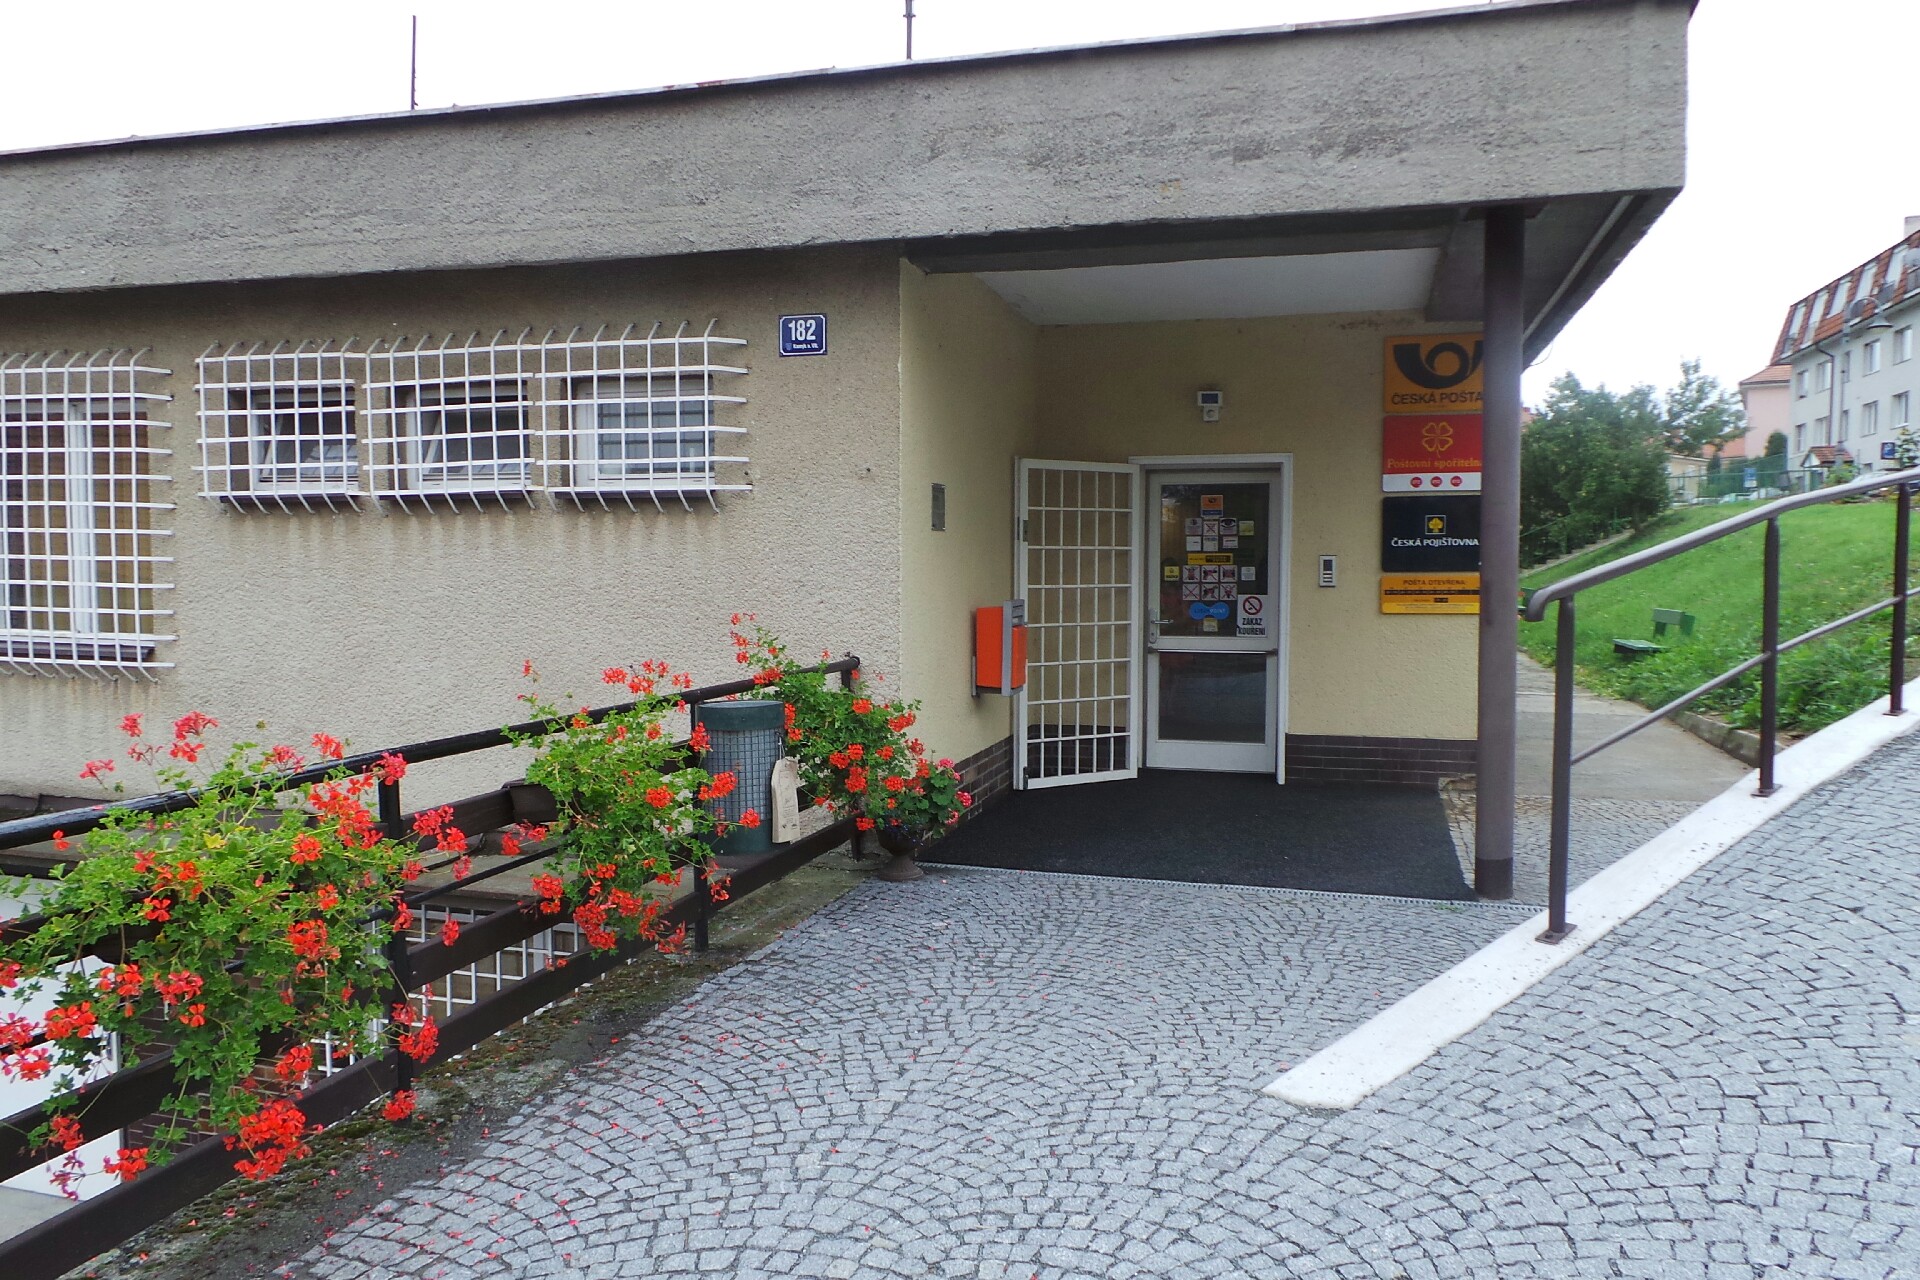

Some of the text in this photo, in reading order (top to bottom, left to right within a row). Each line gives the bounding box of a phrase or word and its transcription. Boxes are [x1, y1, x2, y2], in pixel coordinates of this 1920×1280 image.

[788, 320, 816, 341] 182
[1391, 391, 1436, 405] ČESKÁ
[1387, 458, 1430, 469] Poštovní
[1391, 536, 1480, 547] ČESKÁ POJIŠŤOVNA
